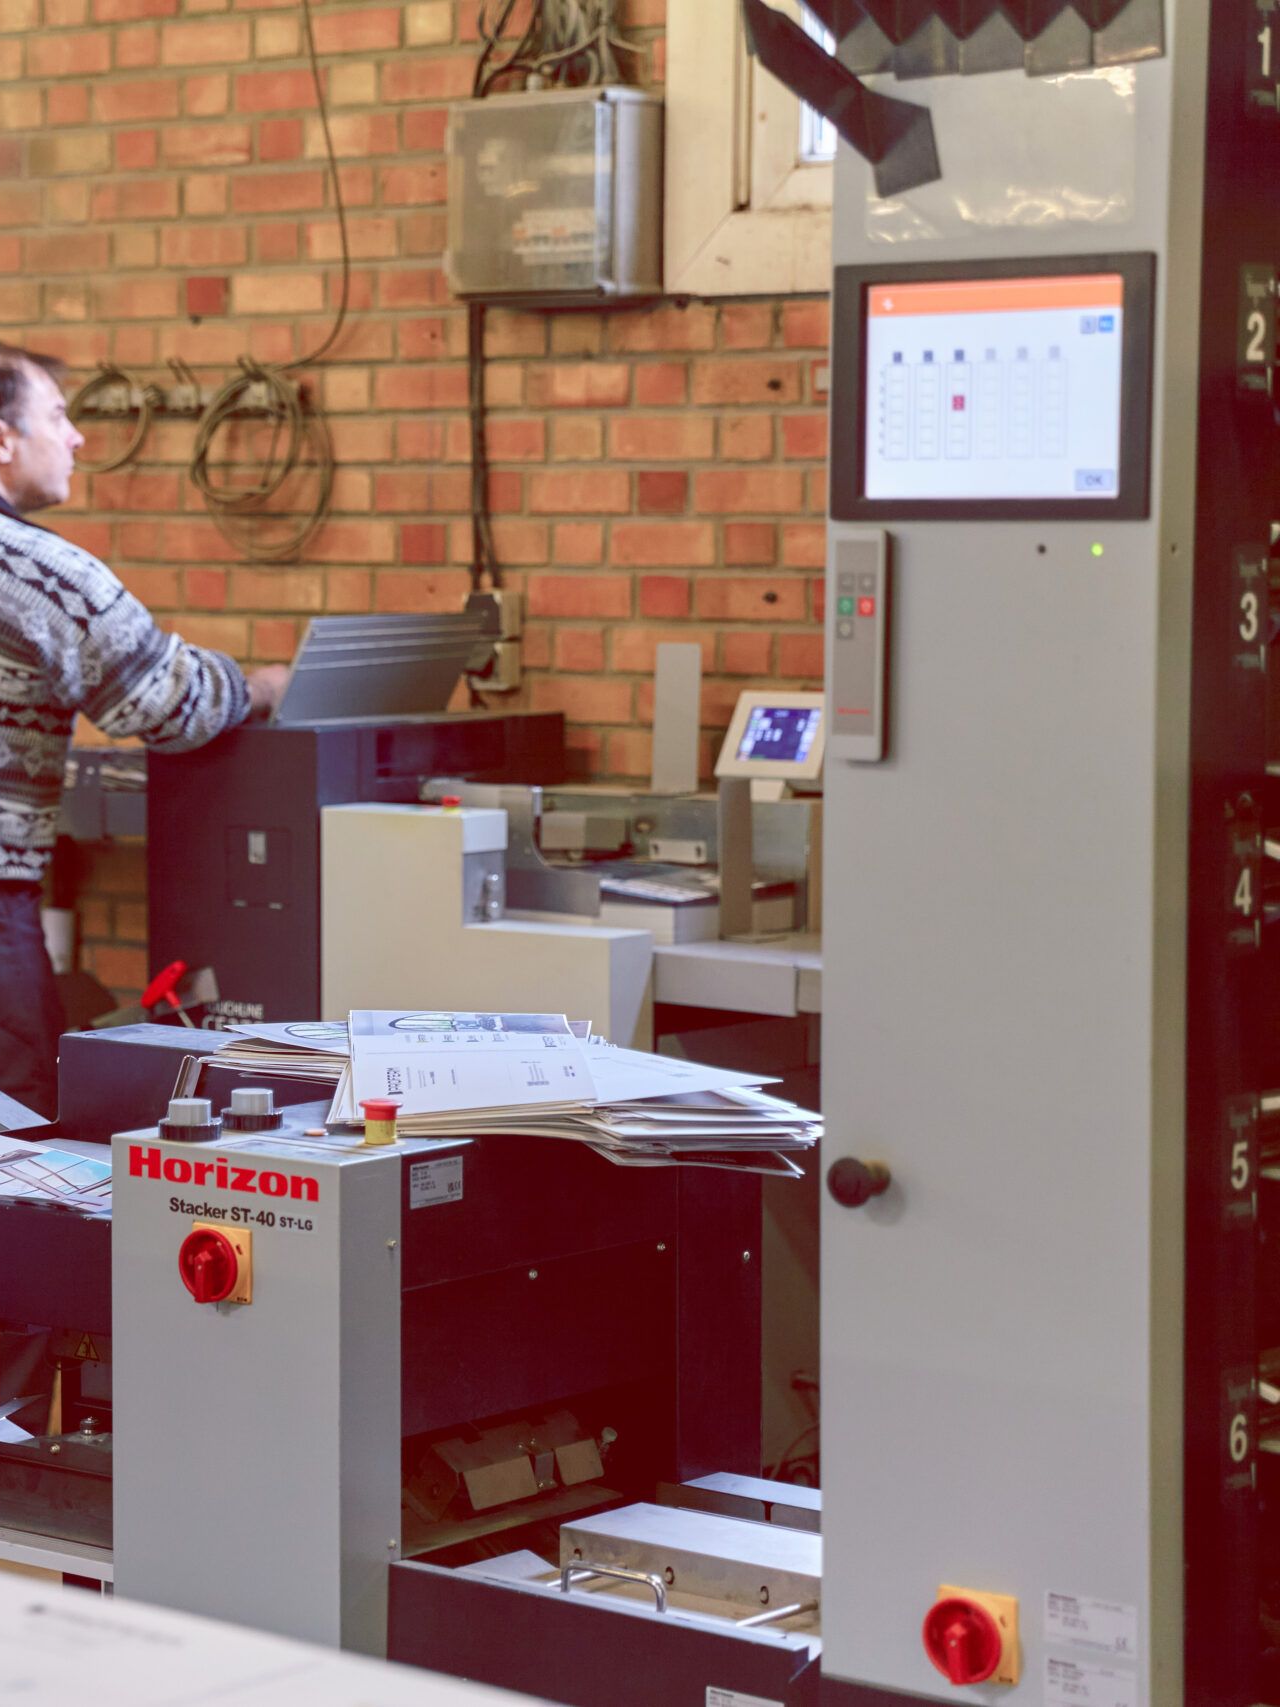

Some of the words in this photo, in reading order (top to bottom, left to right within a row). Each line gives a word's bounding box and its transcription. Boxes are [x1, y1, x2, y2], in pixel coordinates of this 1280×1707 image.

[1257, 26, 1272, 77] 1
[1245, 312, 1267, 361] 2
[1239, 592, 1258, 642] 3
[1234, 868, 1252, 915] 4
[129, 1145, 319, 1202] Horizon
[1231, 1141, 1249, 1190] 5
[169, 1197, 228, 1220] Stacker
[231, 1206, 276, 1227] ST-40
[279, 1216, 313, 1231] ST-LG
[1230, 1413, 1248, 1462] 6
